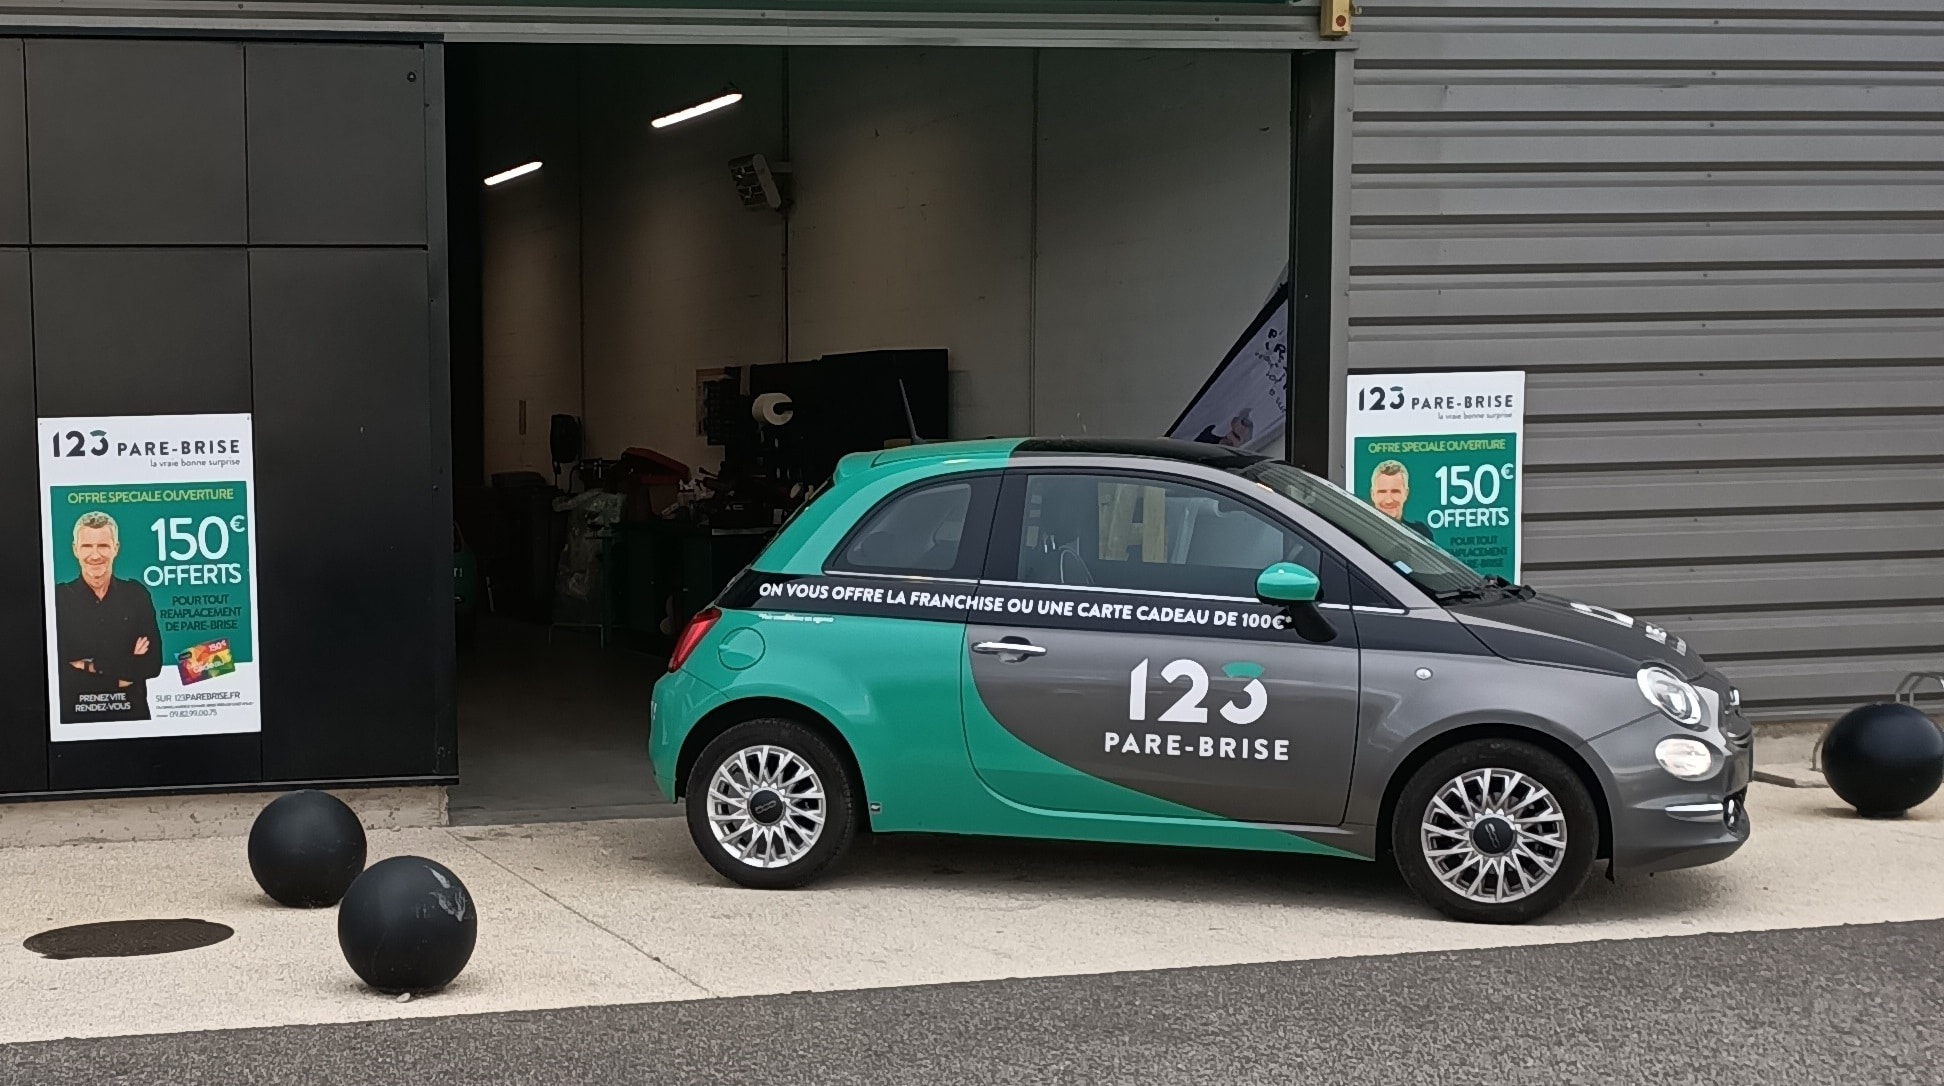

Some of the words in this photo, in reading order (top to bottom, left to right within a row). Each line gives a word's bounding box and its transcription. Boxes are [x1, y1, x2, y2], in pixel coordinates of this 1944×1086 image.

[1358, 386, 1405, 411] 123
[1411, 394, 1514, 410] PARE-BRISE
[53, 430, 109, 457] 123
[118, 439, 240, 457] PARE-BRISE
[1368, 442, 1401, 454] OFFRE
[1402, 440, 1445, 453] SPECIALE
[1446, 438, 1506, 451] OUVERTURE
[181, 458, 207, 467] bonne
[209, 457, 241, 469] surprise
[68, 492, 106, 504] OFFRE
[108, 490, 161, 503] SPECIALE
[163, 488, 235, 501] OUVERTURE
[1427, 507, 1510, 529] OFFERTS
[143, 563, 242, 587] OFFERTS
[172, 595, 203, 606] POUR
[203, 594, 230, 605] TOUT
[759, 583, 783, 597] ON
[786, 584, 829, 600] VOUS
[832, 586, 885, 603] OFFRE
[887, 589, 905, 605] LA
[910, 591, 1004, 613] FRANCHISE
[1007, 598, 1034, 614] OU
[1037, 600, 1074, 617] UNE
[1077, 602, 1133, 620] CARTE
[1136, 606, 1210, 625] CADEAU
[1213, 610, 1239, 627] DE
[160, 606, 242, 619] REMPLACEMENT
[165, 621, 180, 632] DE
[180, 619, 238, 631] PARE-BRISE
[79, 693, 109, 703] PRENEZ
[1129, 658, 1268, 725] 123
[75, 702, 131, 713] RENDEZ-VOUS
[1104, 731, 1290, 761] PARE-BRISE
